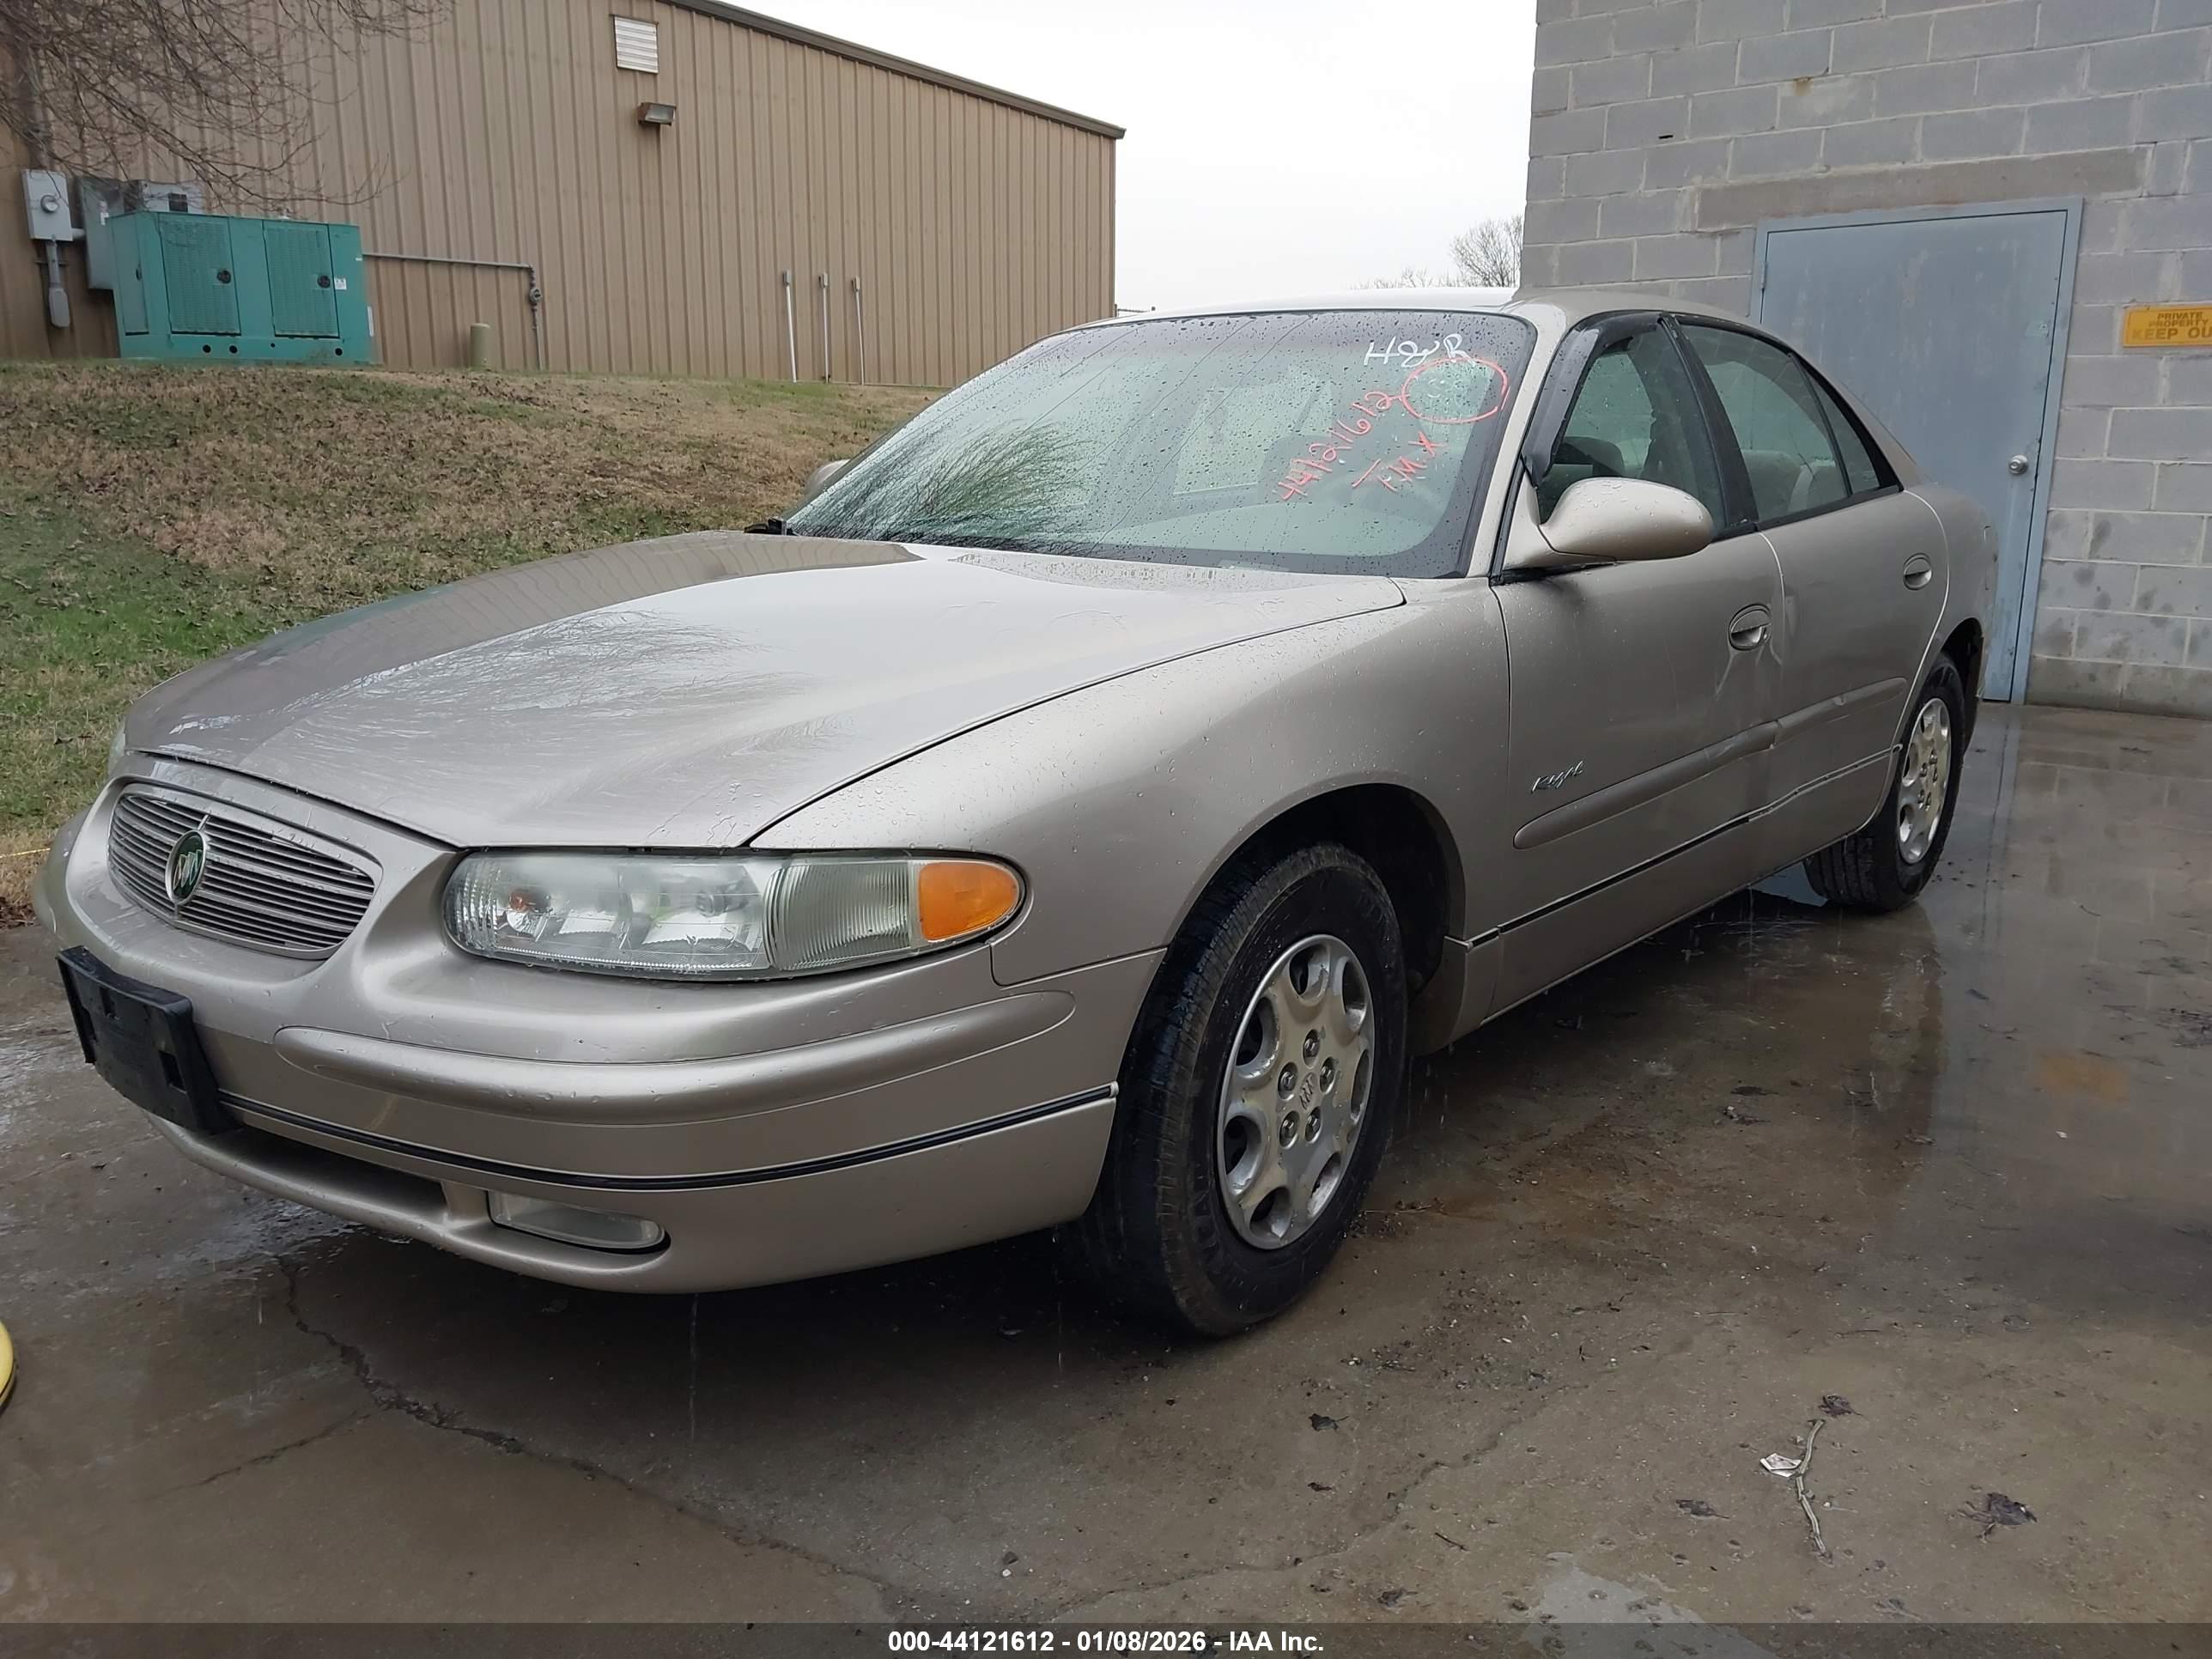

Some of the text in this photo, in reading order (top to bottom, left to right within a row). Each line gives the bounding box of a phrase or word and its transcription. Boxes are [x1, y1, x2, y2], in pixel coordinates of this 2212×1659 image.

[2157, 312, 2203, 320] PRIVATE
[2148, 319, 2209, 327] PROPERTY
[2132, 327, 2212, 340] KEEP OU
